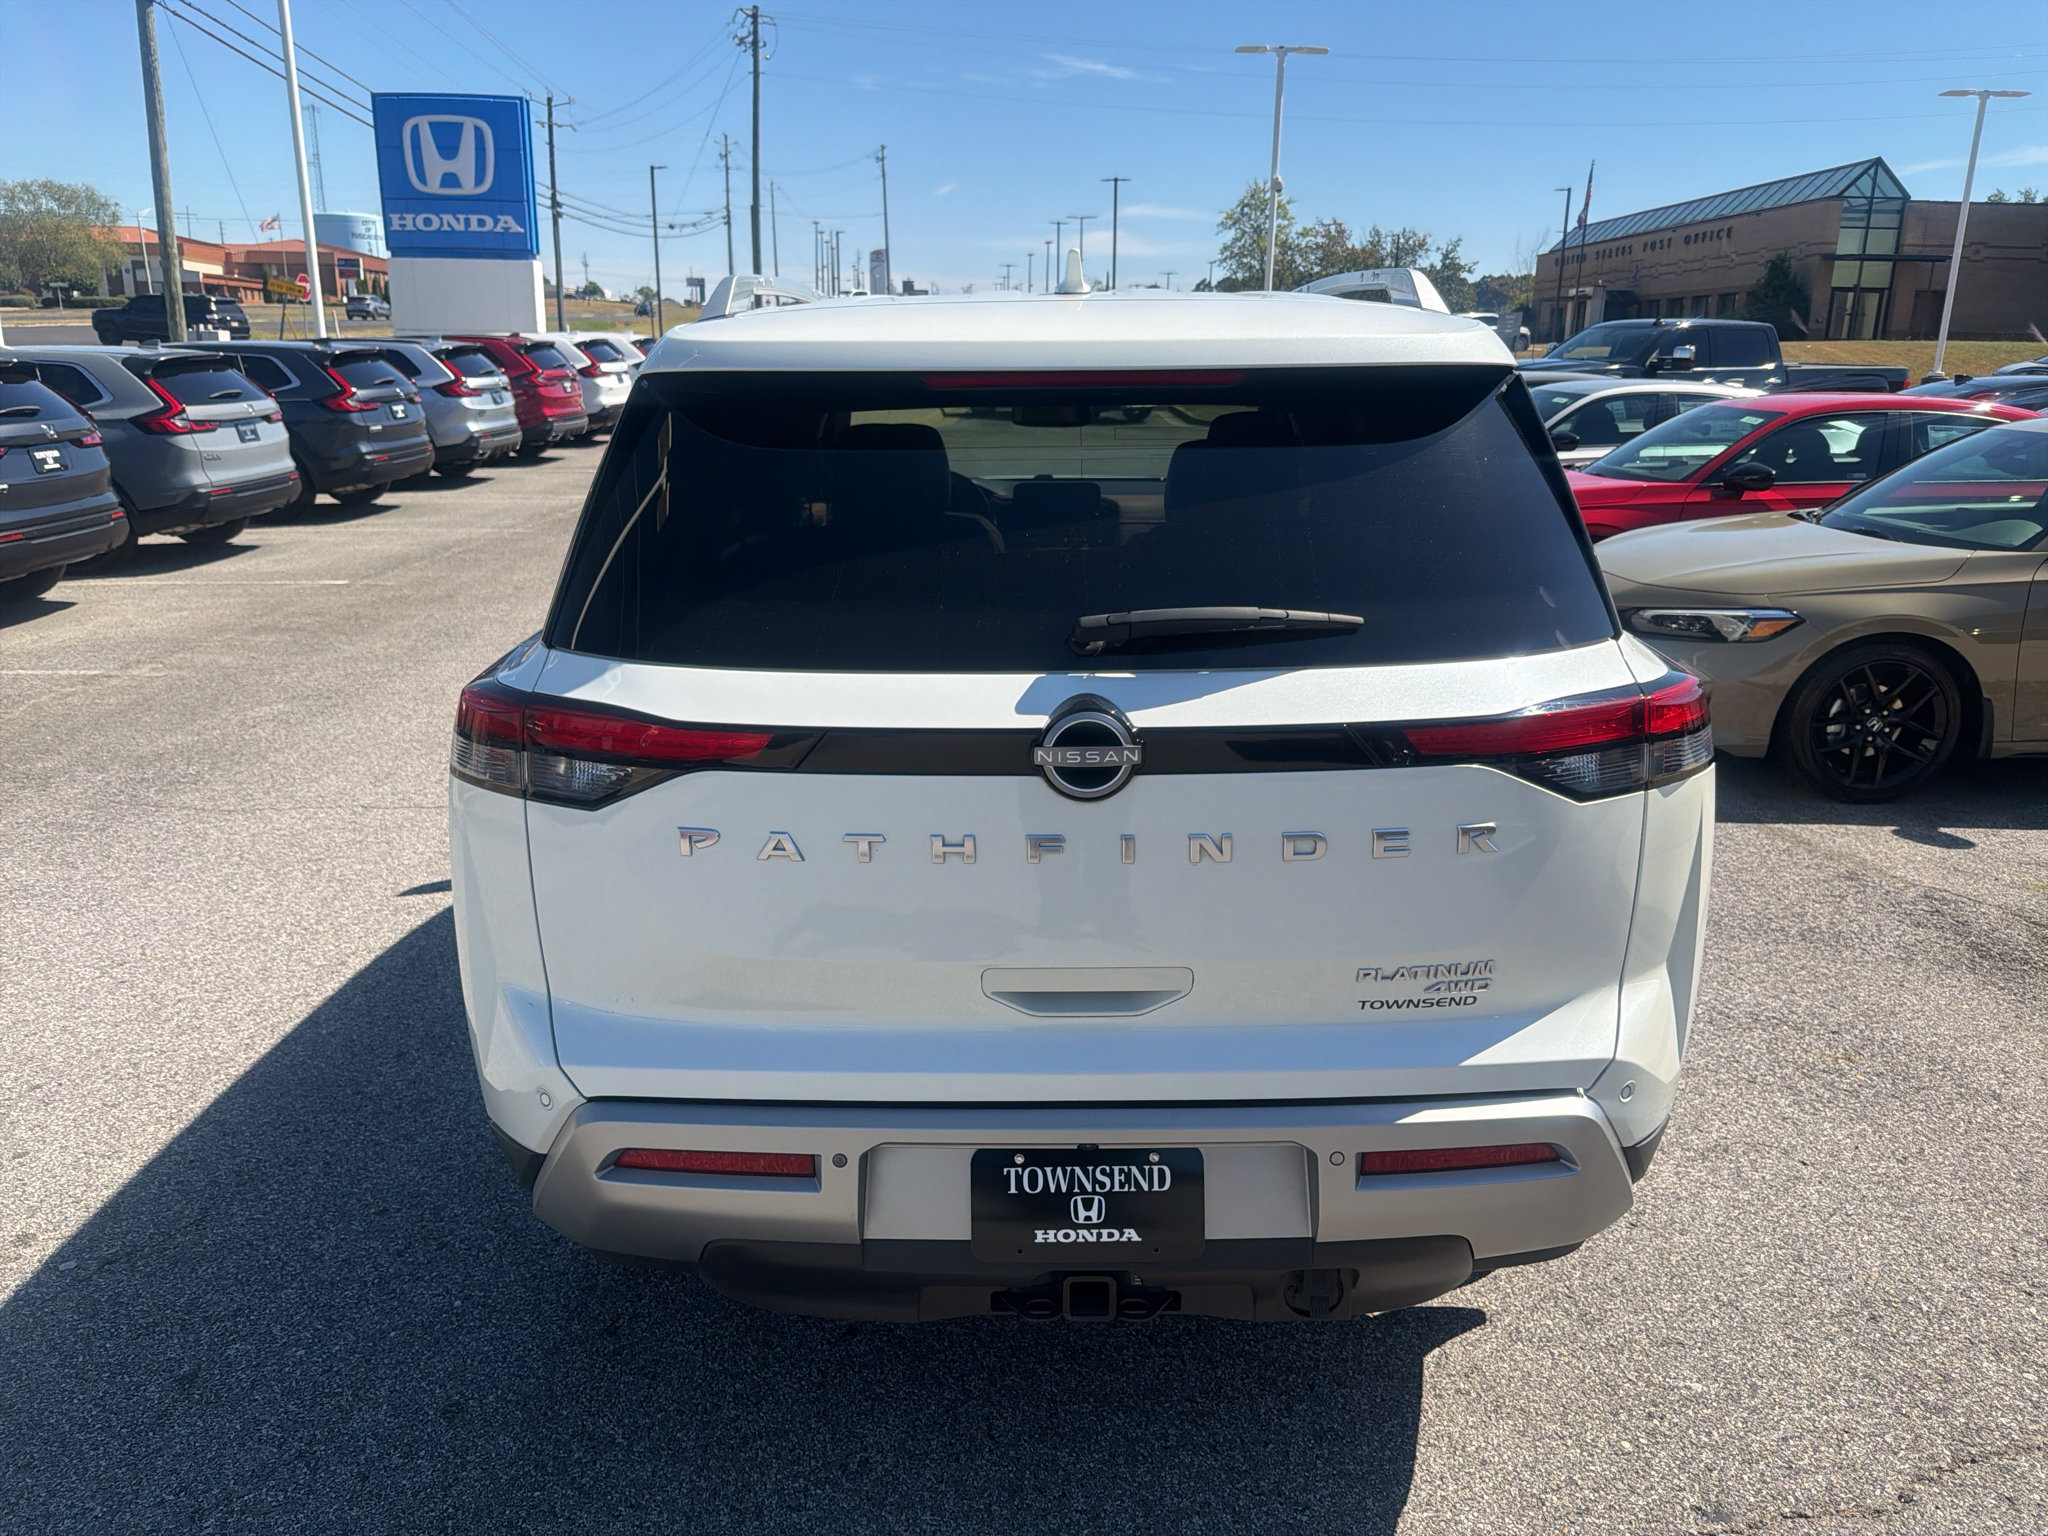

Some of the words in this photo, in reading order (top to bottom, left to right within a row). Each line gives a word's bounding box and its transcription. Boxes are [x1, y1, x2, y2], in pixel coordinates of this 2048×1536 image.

[388, 212, 525, 233] HONDA
[1642, 237, 1673, 253] POST
[1683, 225, 1734, 246] OFFICE
[1037, 749, 1139, 763] NISSAN
[677, 821, 1499, 865] PATHFINDER
[1356, 959, 1495, 983] PLATINUM
[1423, 977, 1493, 995] 4WD
[1358, 995, 1478, 1010] TOWNSEND
[1003, 1165, 1172, 1194] TOWNSEND
[1034, 1228, 1142, 1243] HONDA
